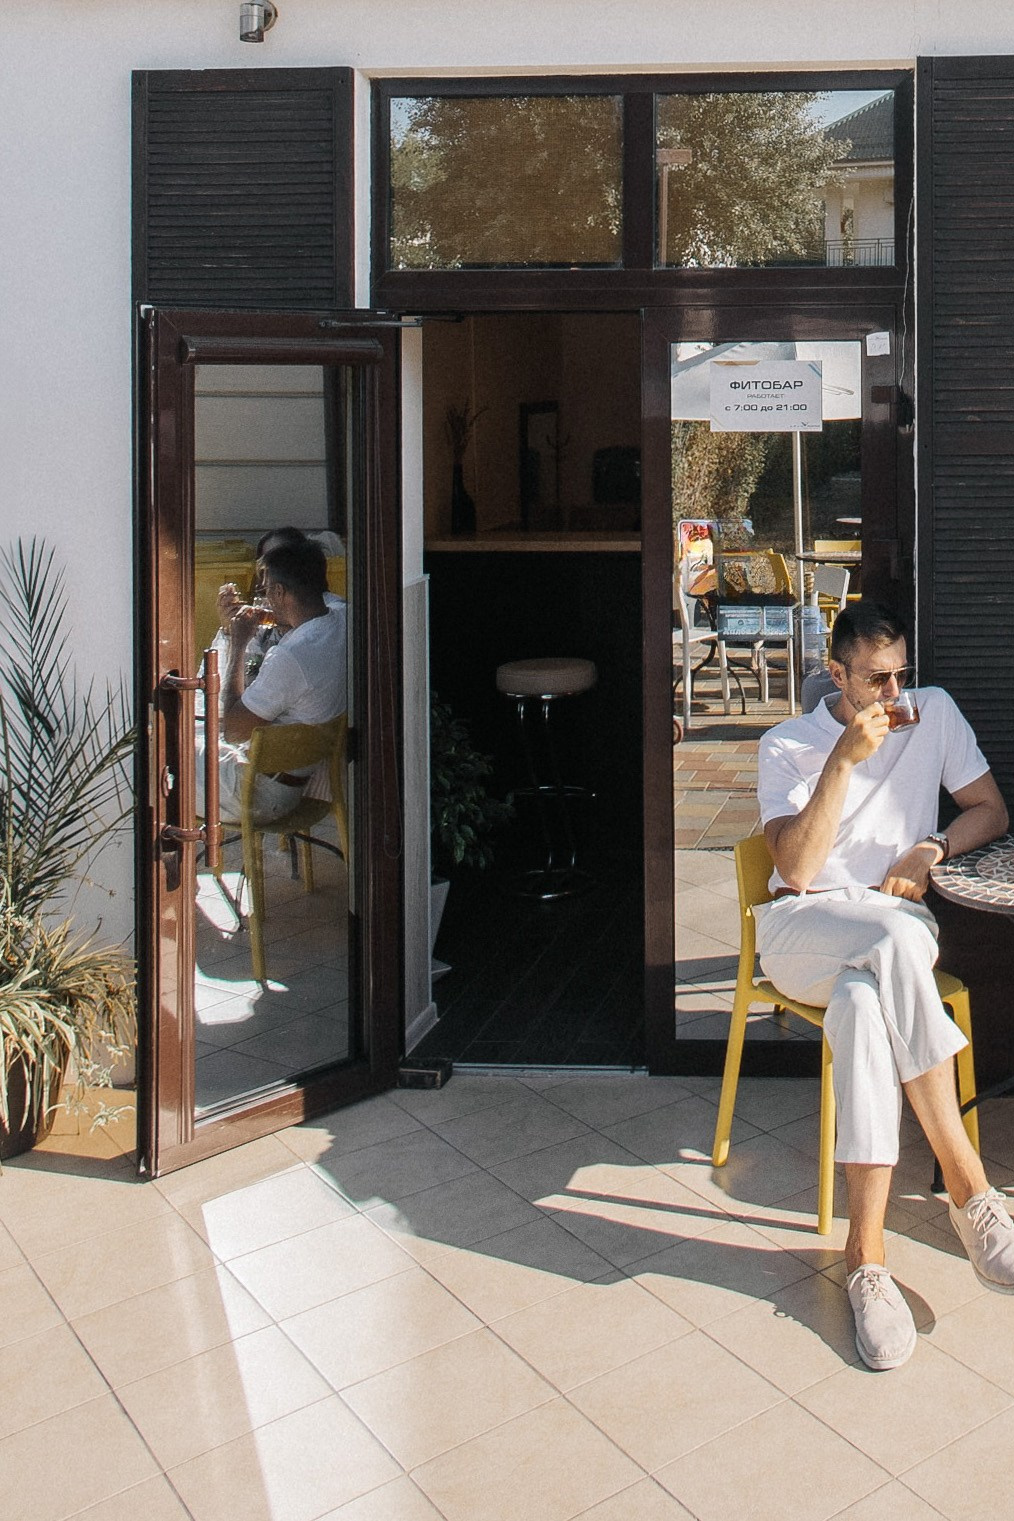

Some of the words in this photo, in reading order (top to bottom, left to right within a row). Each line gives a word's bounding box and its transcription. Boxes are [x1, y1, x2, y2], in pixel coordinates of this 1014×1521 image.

[729, 380, 804, 391] ФИТОБАР
[733, 403, 758, 412] 7:00
[760, 404, 774, 412] до
[775, 403, 808, 412] 21:00
